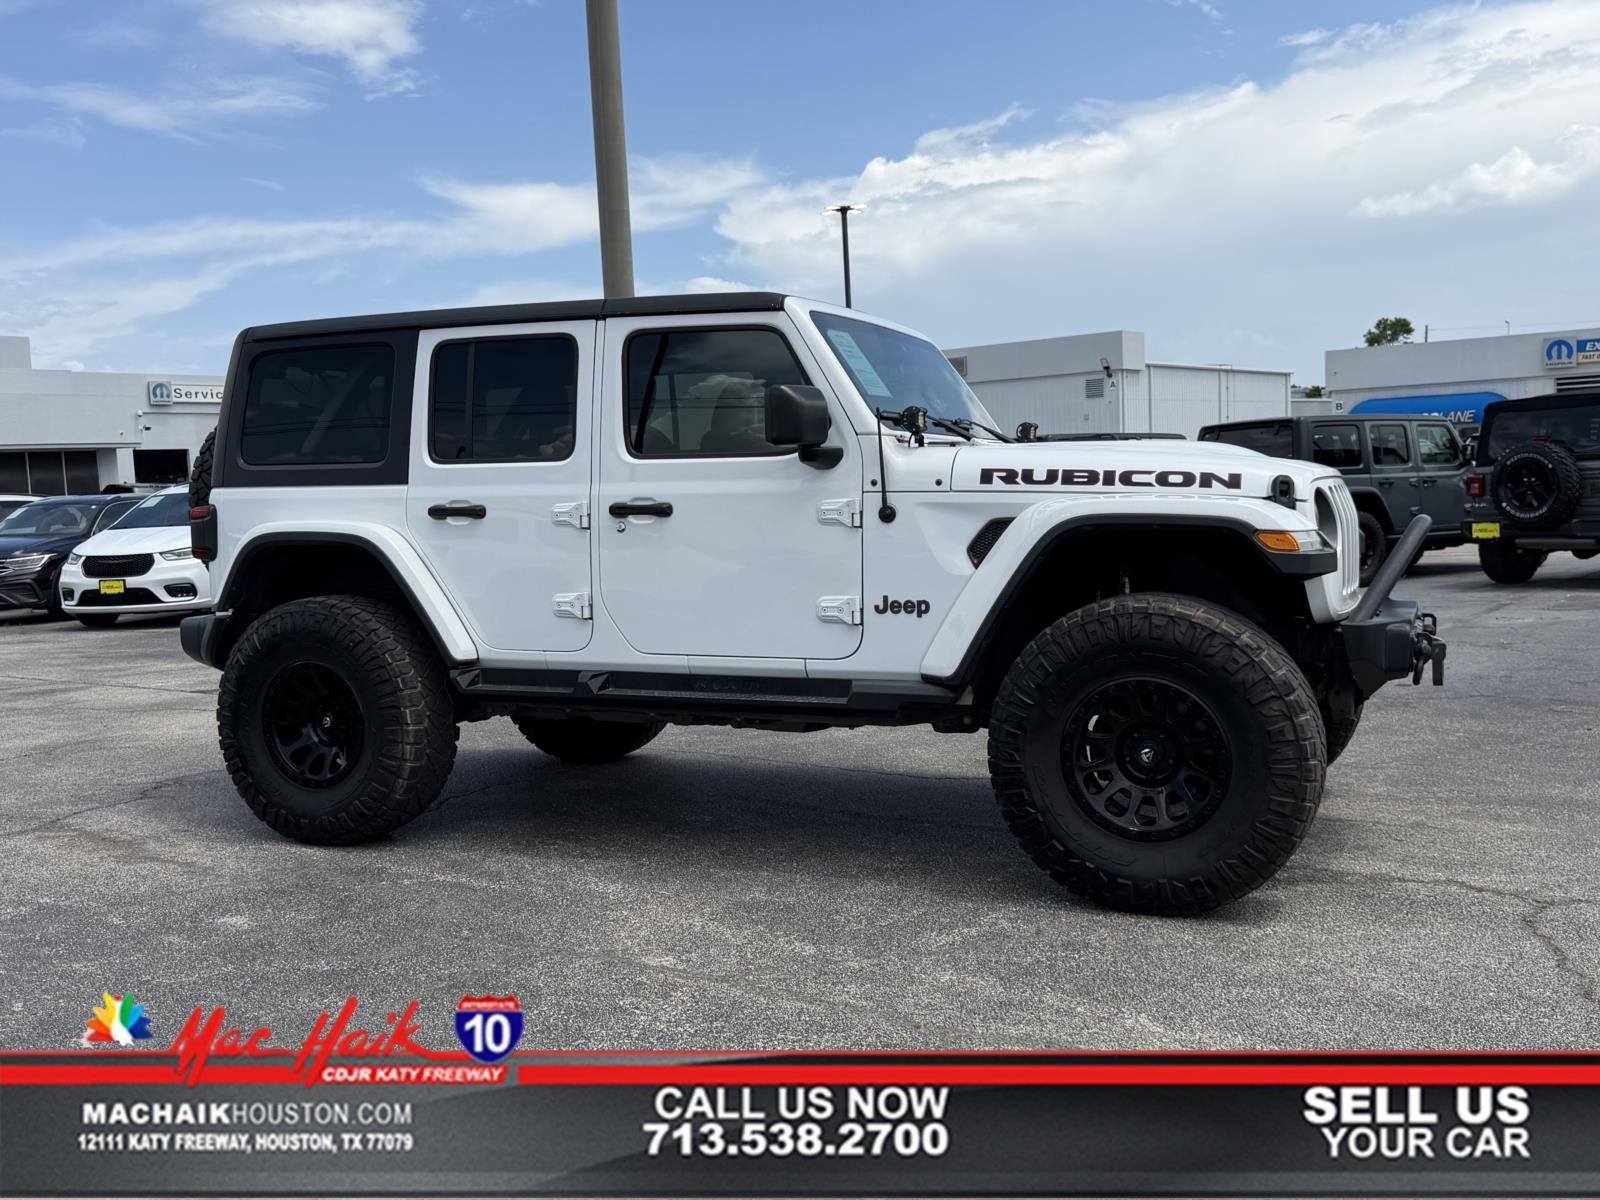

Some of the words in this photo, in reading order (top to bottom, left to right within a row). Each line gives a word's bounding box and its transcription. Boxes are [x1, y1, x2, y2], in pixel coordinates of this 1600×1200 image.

[1335, 403, 1342, 411] B
[979, 468, 1242, 489] RUBICON
[874, 595, 930, 618] Jeep
